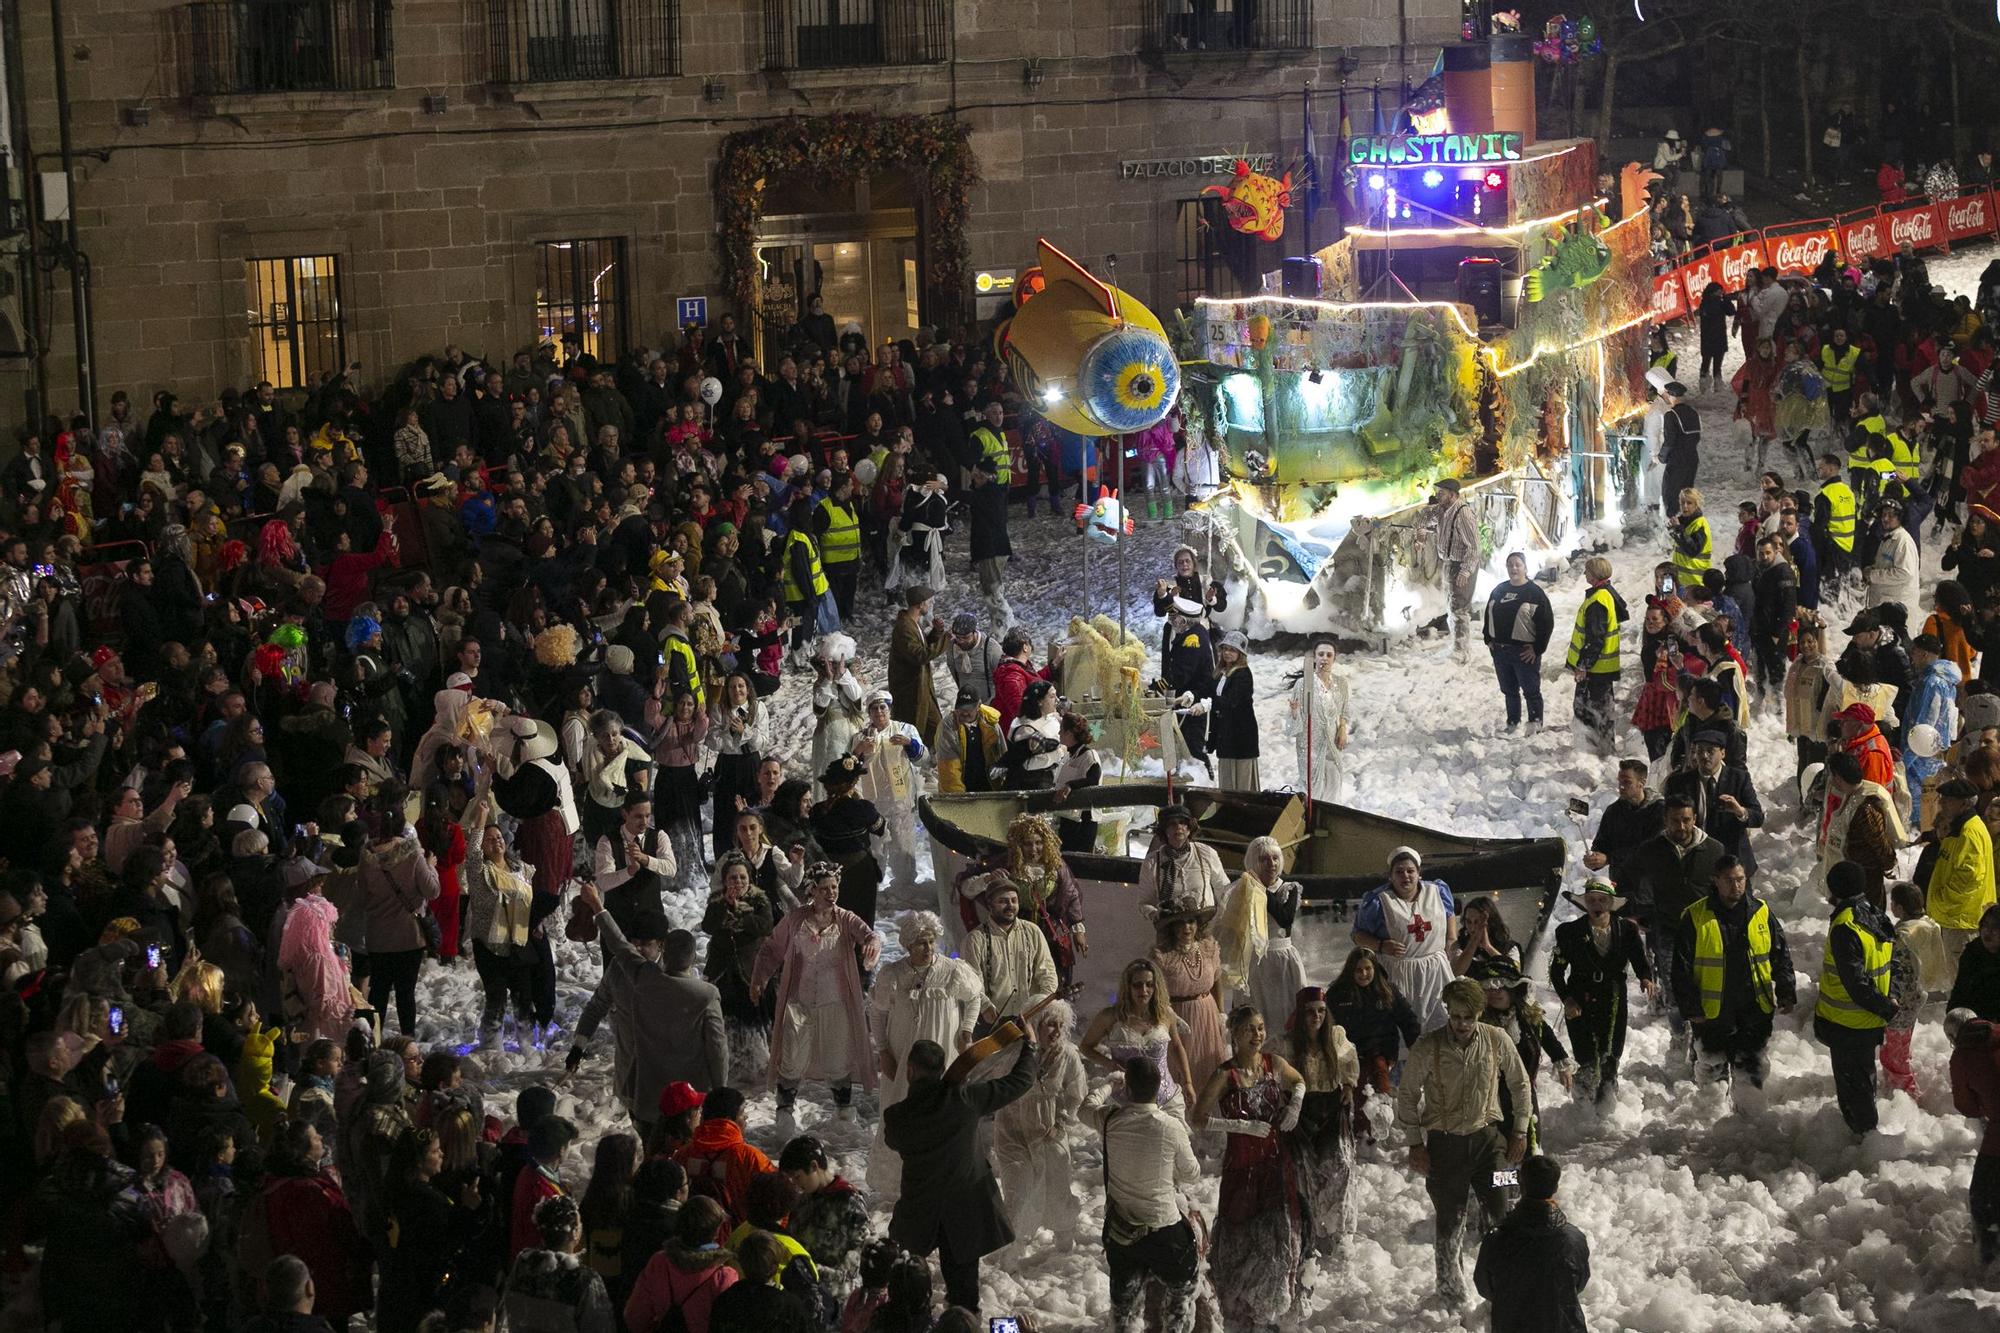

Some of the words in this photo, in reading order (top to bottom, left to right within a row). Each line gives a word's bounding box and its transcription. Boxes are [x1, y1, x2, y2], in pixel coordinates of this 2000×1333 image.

[1350, 134, 1521, 164] GHOSTANIC
[1123, 160, 1197, 179] PALACIO
[1201, 158, 1224, 175] DE
[1891, 212, 1932, 245] Coca-Cola
[1948, 200, 1984, 232] Coca-Cola
[1848, 223, 1880, 257] Coca-Cola
[684, 301, 701, 318] H
[1211, 324, 1225, 341] 25
